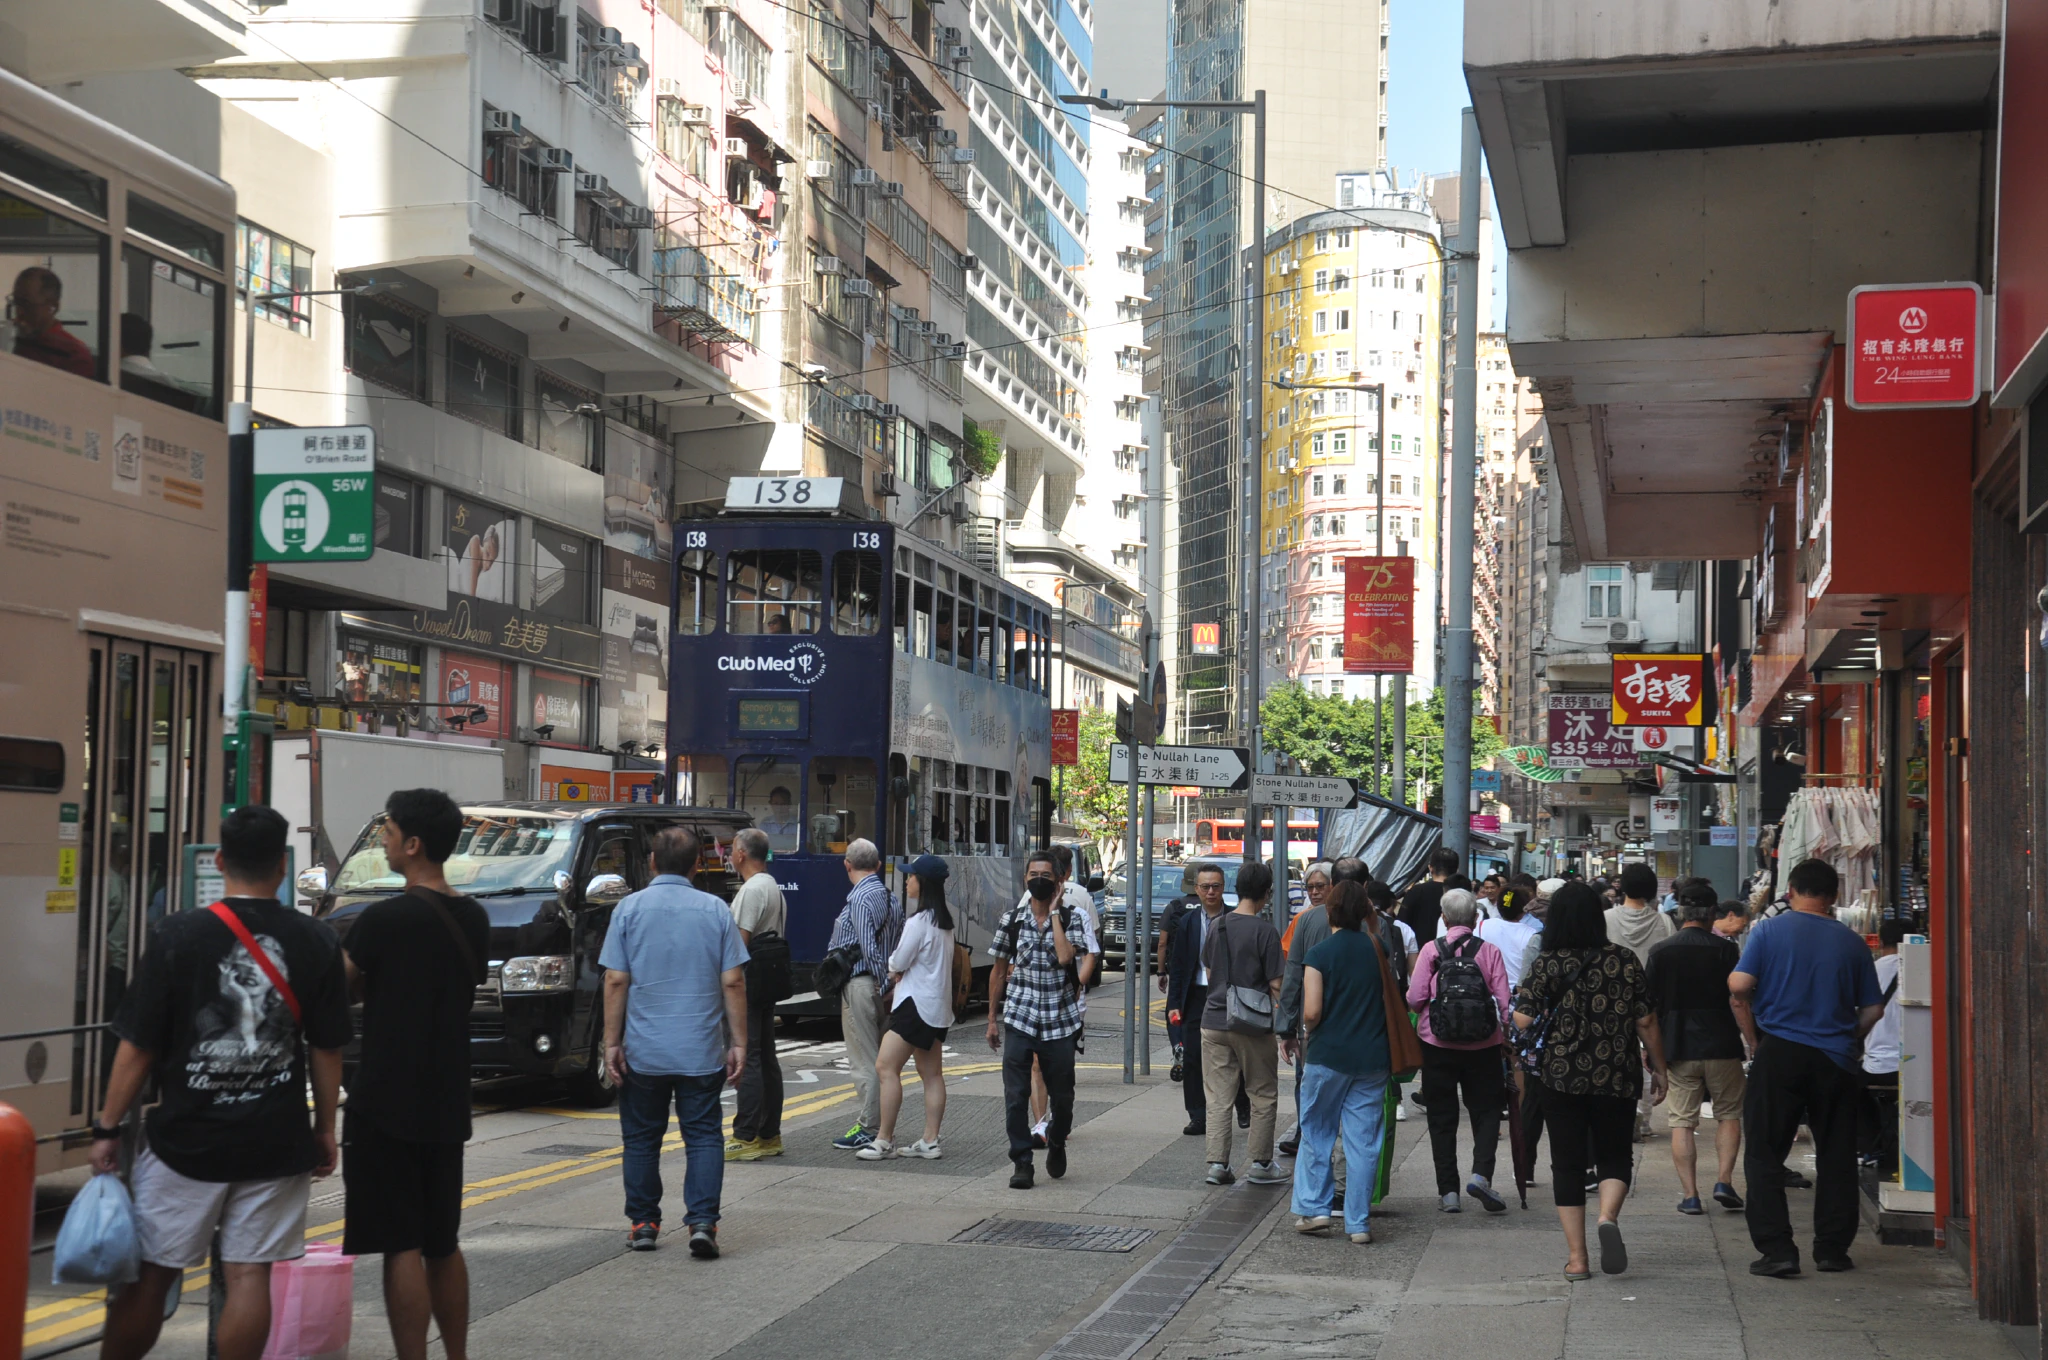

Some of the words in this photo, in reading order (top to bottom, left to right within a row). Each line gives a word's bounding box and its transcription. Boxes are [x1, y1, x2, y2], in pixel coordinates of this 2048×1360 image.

[1862, 337, 1964, 355] 招商永隆銀行
[1874, 366, 1899, 384] 24
[305, 455, 340, 463] O'Brien
[342, 454, 366, 463] Road
[332, 479, 366, 491] 56W
[755, 480, 811, 504] 138
[686, 531, 707, 548] 138
[853, 532, 880, 548] 138
[1362, 562, 1396, 592] 75
[1349, 593, 1409, 602] CELEBRATING
[413, 611, 452, 636] Sweet
[452, 600, 492, 644] Dream
[500, 616, 550, 653] 金美夢
[789, 642, 825, 658] EXCLUSIVE
[718, 656, 755, 671] Club
[757, 656, 795, 671] Med
[789, 664, 827, 684] COLLECTION
[1621, 663, 1691, 708] すき家
[740, 702, 773, 714] Kennedy
[1551, 696, 1590, 709] 泰舒適
[1054, 713, 1069, 727] 75
[1551, 741, 1588, 755] $35
[1591, 741, 1637, 755] 半小
[1117, 749, 1148, 760] Stne
[1153, 751, 1189, 761] Nullah
[1194, 753, 1219, 763] Lane
[1585, 757, 1611, 766] Massage
[1614, 757, 1634, 766] Beauty
[1138, 765, 1200, 781] 石水渠街
[1256, 778, 1281, 786] Stone
[1285, 780, 1314, 788] Nullah
[1318, 781, 1338, 789] Lane
[1272, 791, 1320, 803] 石水渠街
